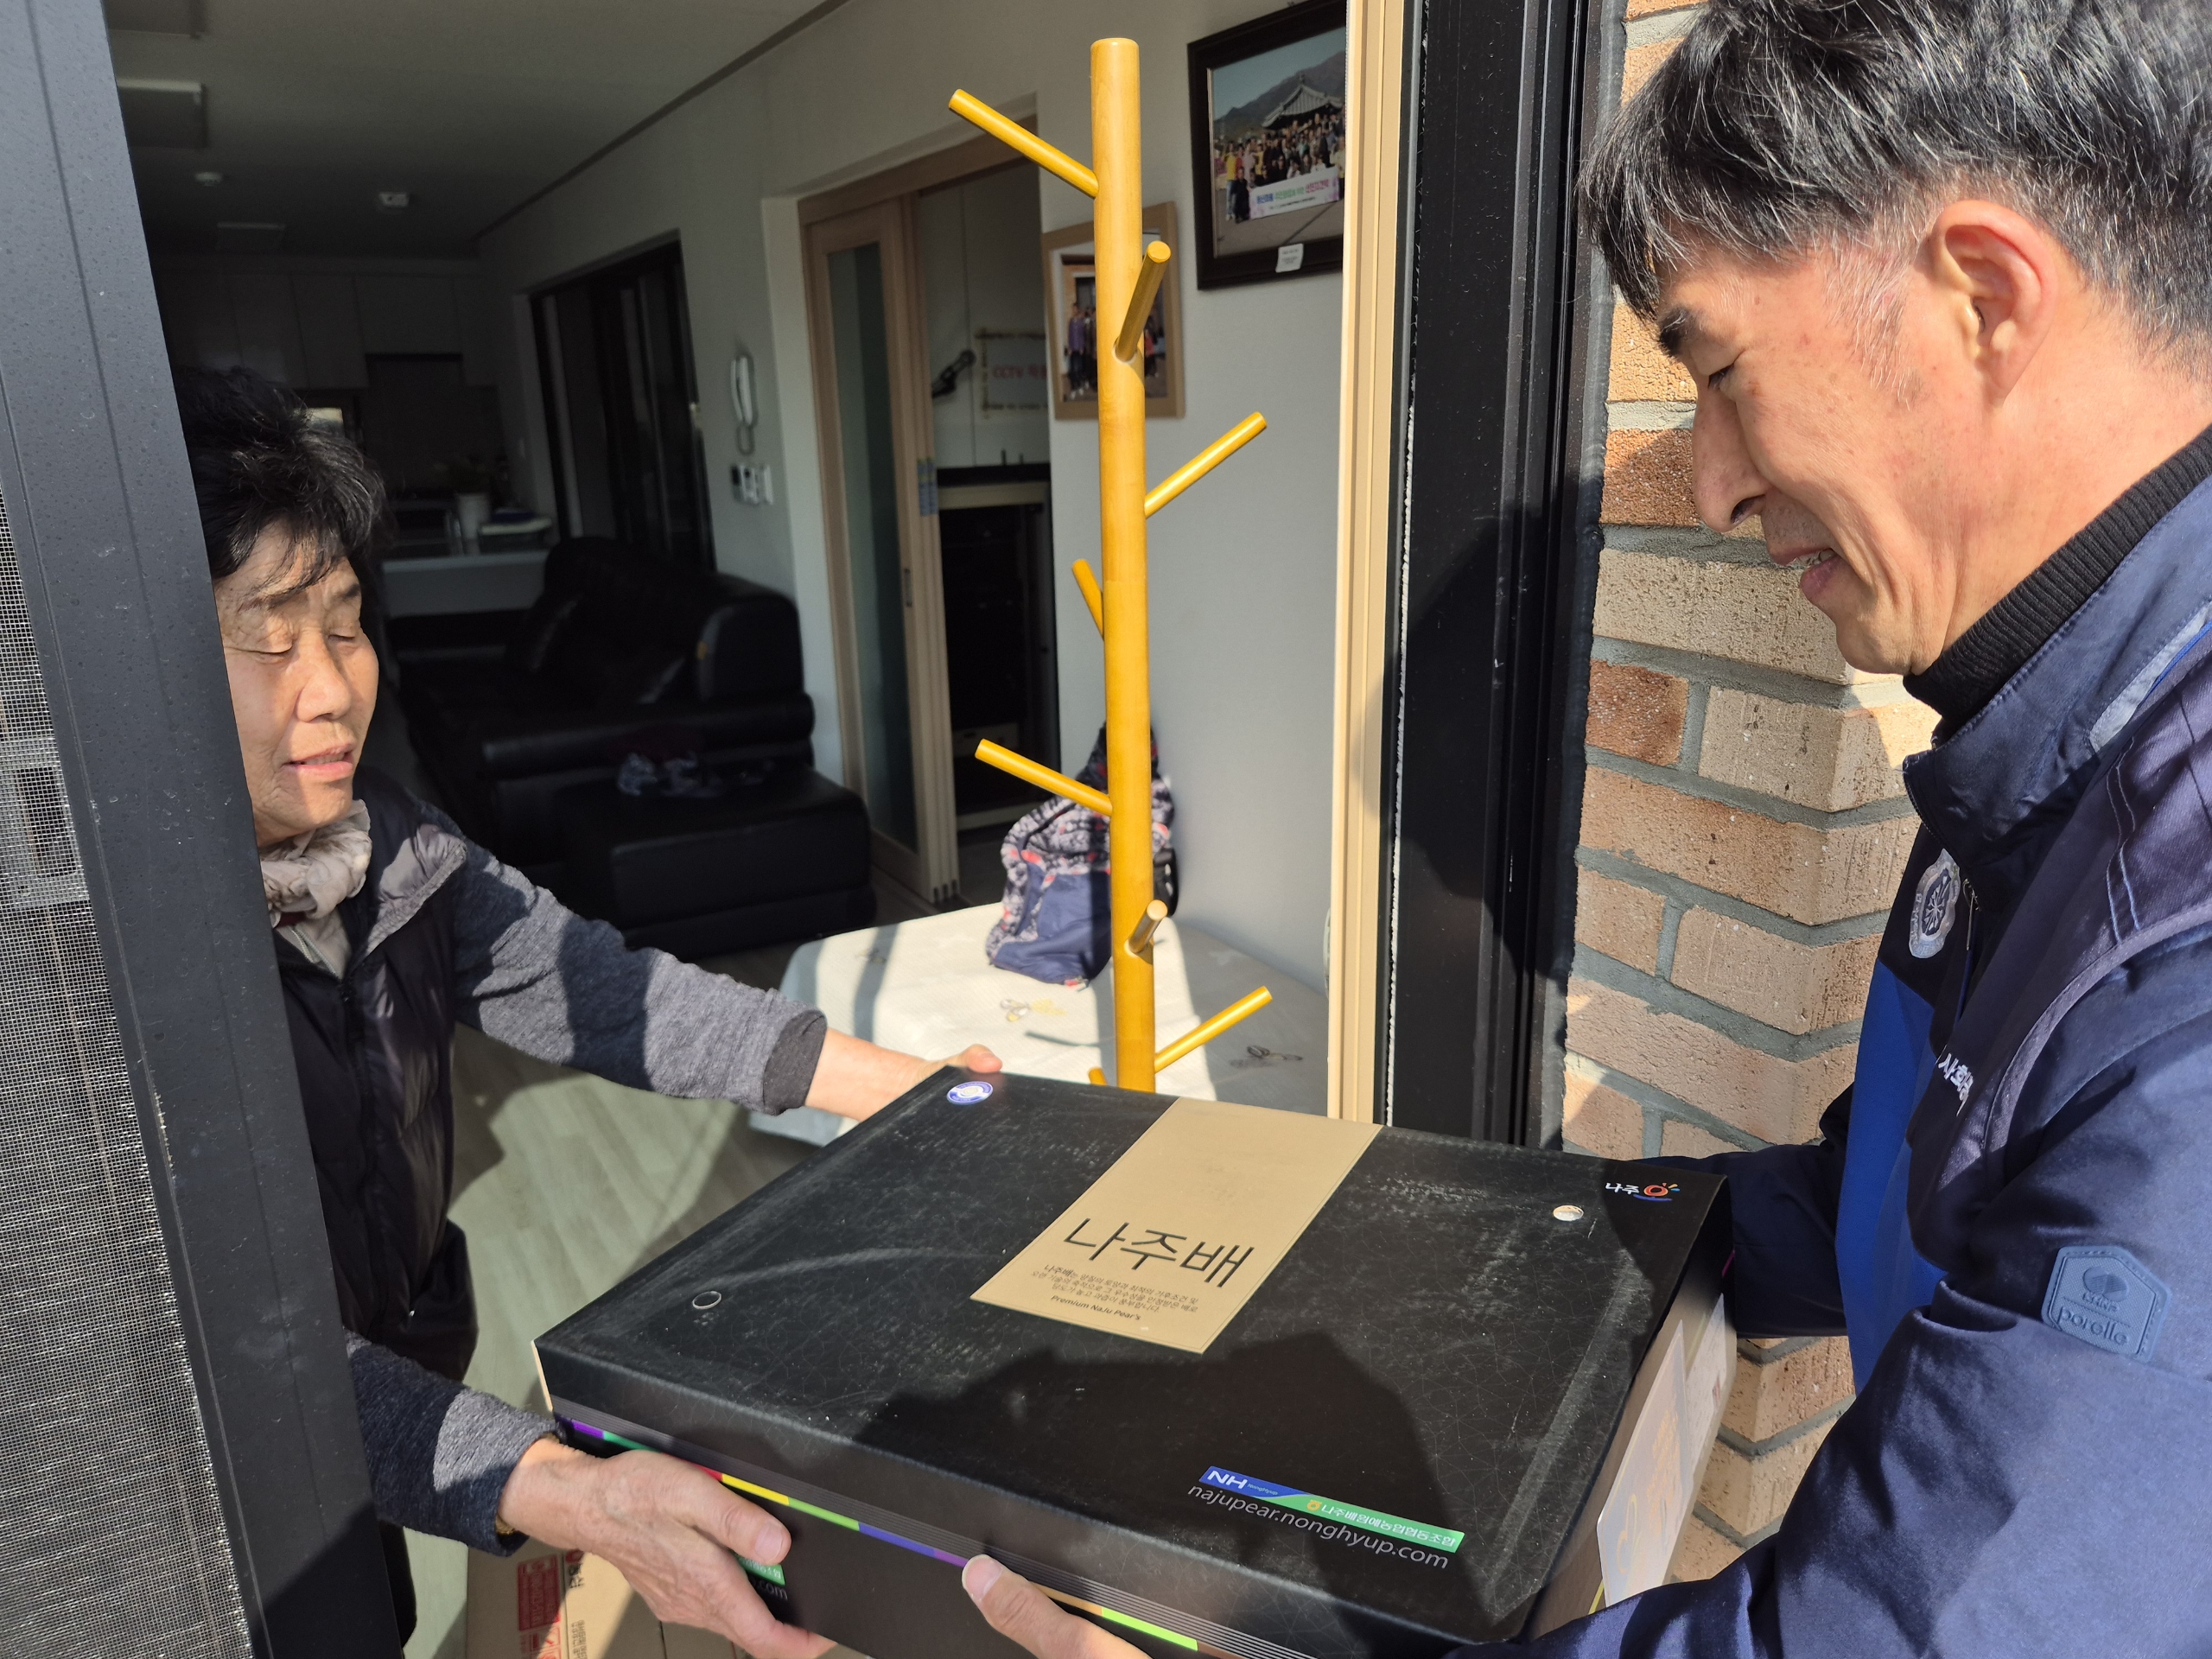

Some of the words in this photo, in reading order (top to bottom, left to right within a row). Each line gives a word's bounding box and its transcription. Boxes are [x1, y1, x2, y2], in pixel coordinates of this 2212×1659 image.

[1605, 1182, 1640, 1195] 나주
[1064, 1217, 1255, 1287] 나주배
[1044, 1264, 1079, 1278] 나주배는
[1154, 1289, 1189, 1303] 기후조건
[1051, 1295, 1089, 1308] Premium
[1114, 1309, 1141, 1320] Pear's
[1207, 1470, 1248, 1489] NH
[1187, 1486, 1449, 1569] najupear.nonghyup.com
[1321, 1504, 1457, 1548] 나주배원예농업협동조합
